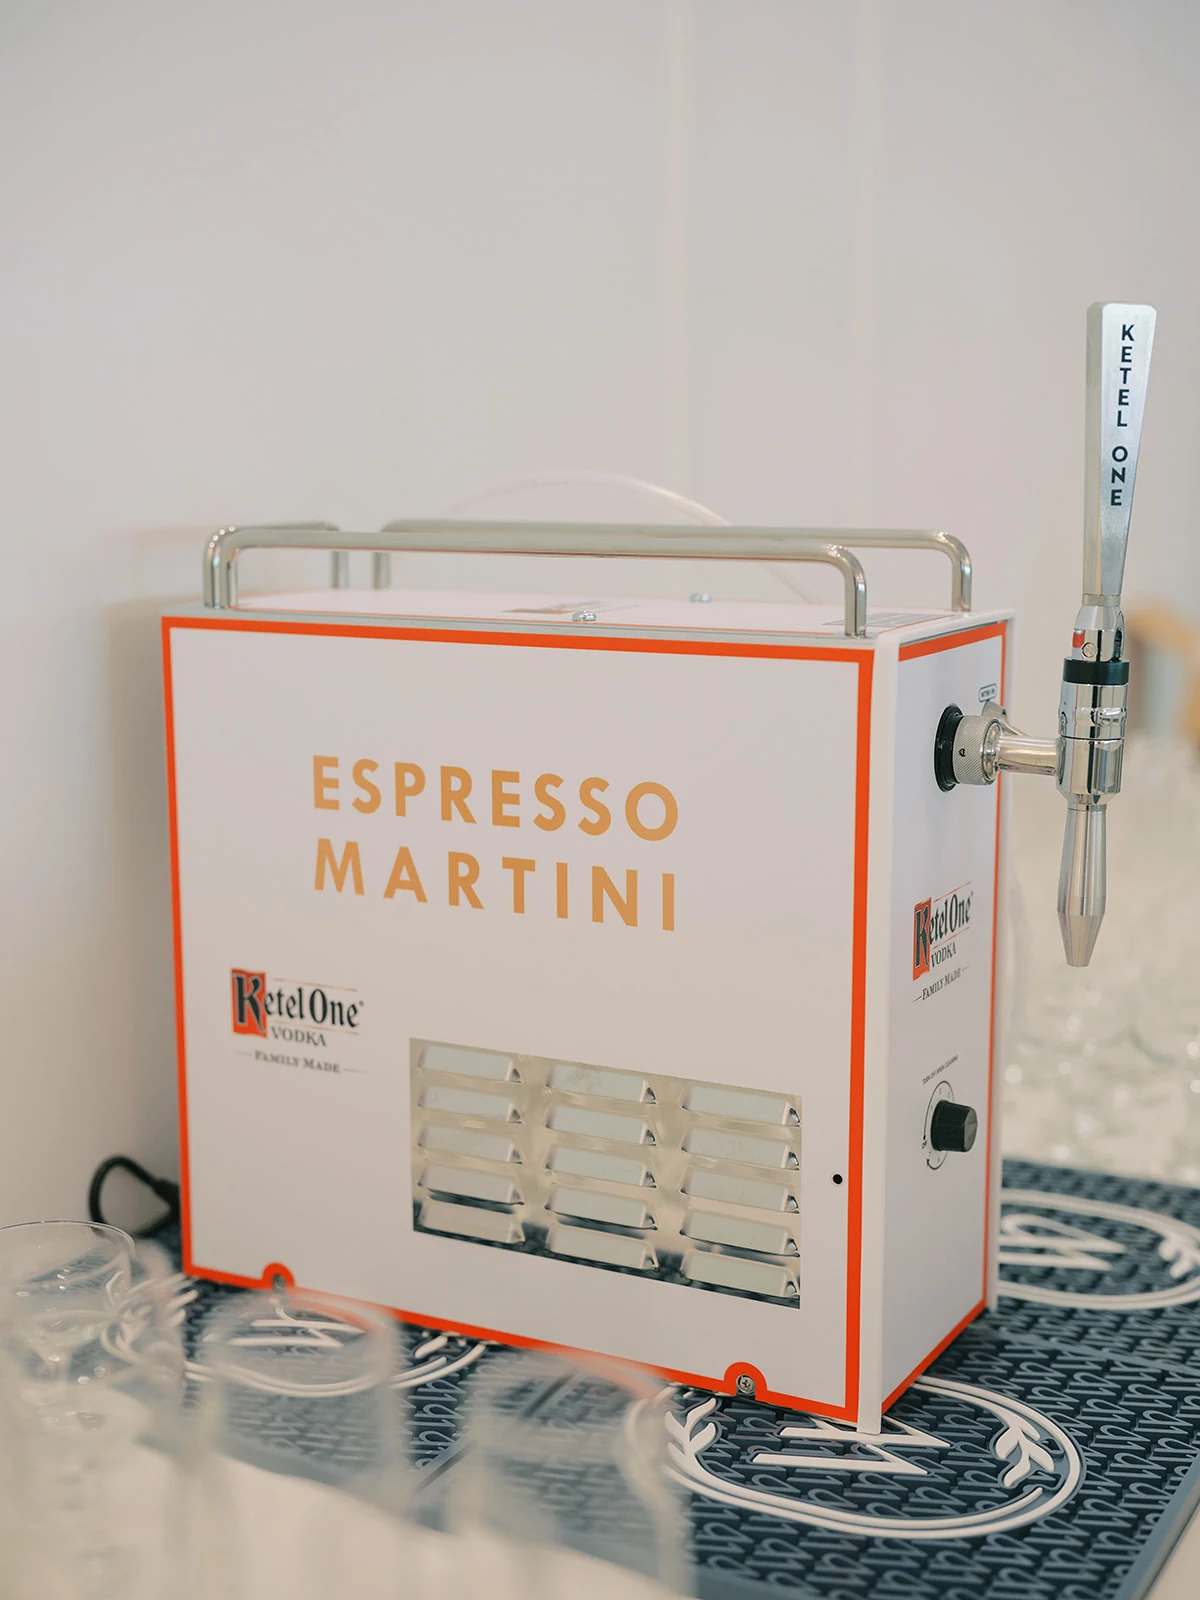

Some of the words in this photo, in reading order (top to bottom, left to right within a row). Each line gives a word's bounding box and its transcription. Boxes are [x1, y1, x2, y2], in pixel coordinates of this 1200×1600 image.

[1116, 324, 1135, 427] KETEL
[1110, 445, 1129, 506] ONE
[313, 755, 678, 841] ESPRESSO
[314, 838, 675, 931] MARTINI
[915, 898, 948, 968] Ketel
[931, 941, 957, 968] VODKA
[235, 975, 304, 1032] Ketel
[271, 1026, 327, 1047] VODKA
